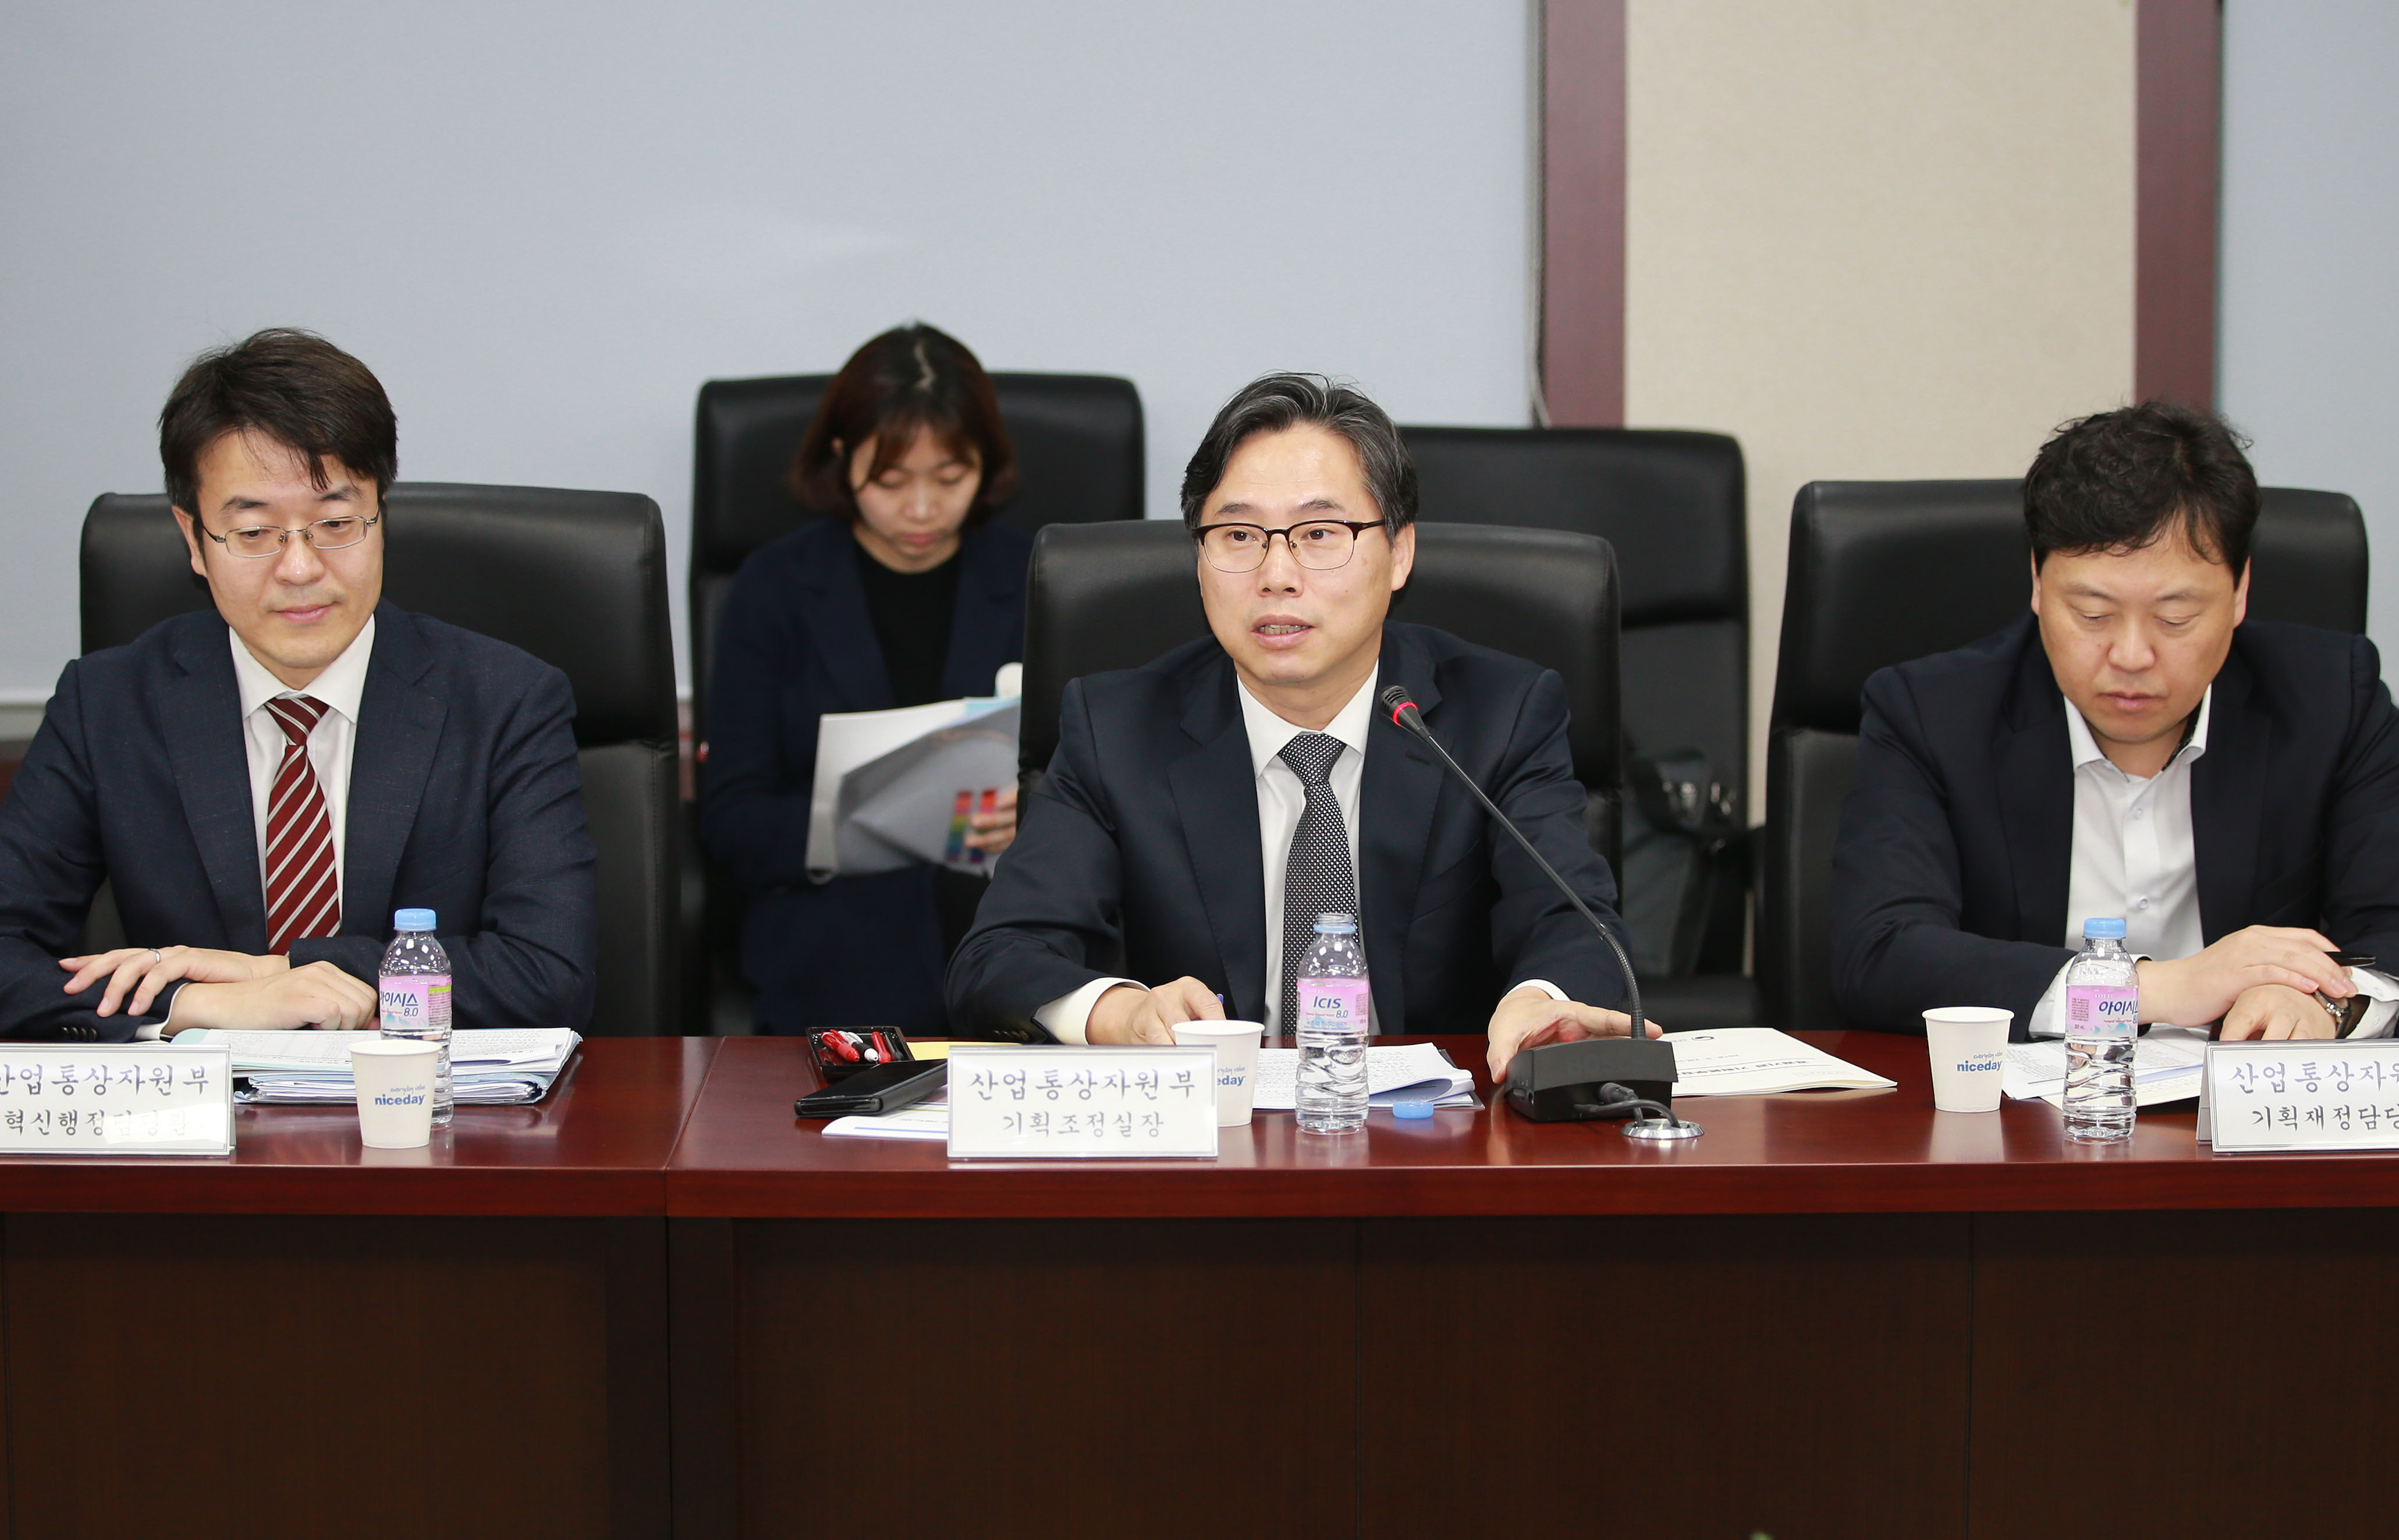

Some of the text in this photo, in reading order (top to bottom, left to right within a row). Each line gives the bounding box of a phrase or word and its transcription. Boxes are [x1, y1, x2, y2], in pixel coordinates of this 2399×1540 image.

[1313, 996, 1342, 1009] ICIS
[403, 1007, 418, 1017] 8.0
[1336, 1010, 1349, 1019] 8.0
[1957, 1060, 2002, 1071] niceday
[967, 1069, 1195, 1101] 산업통상자원부
[374, 1094, 425, 1106] niceday
[1002, 1111, 1164, 1138] 기획조정실장
